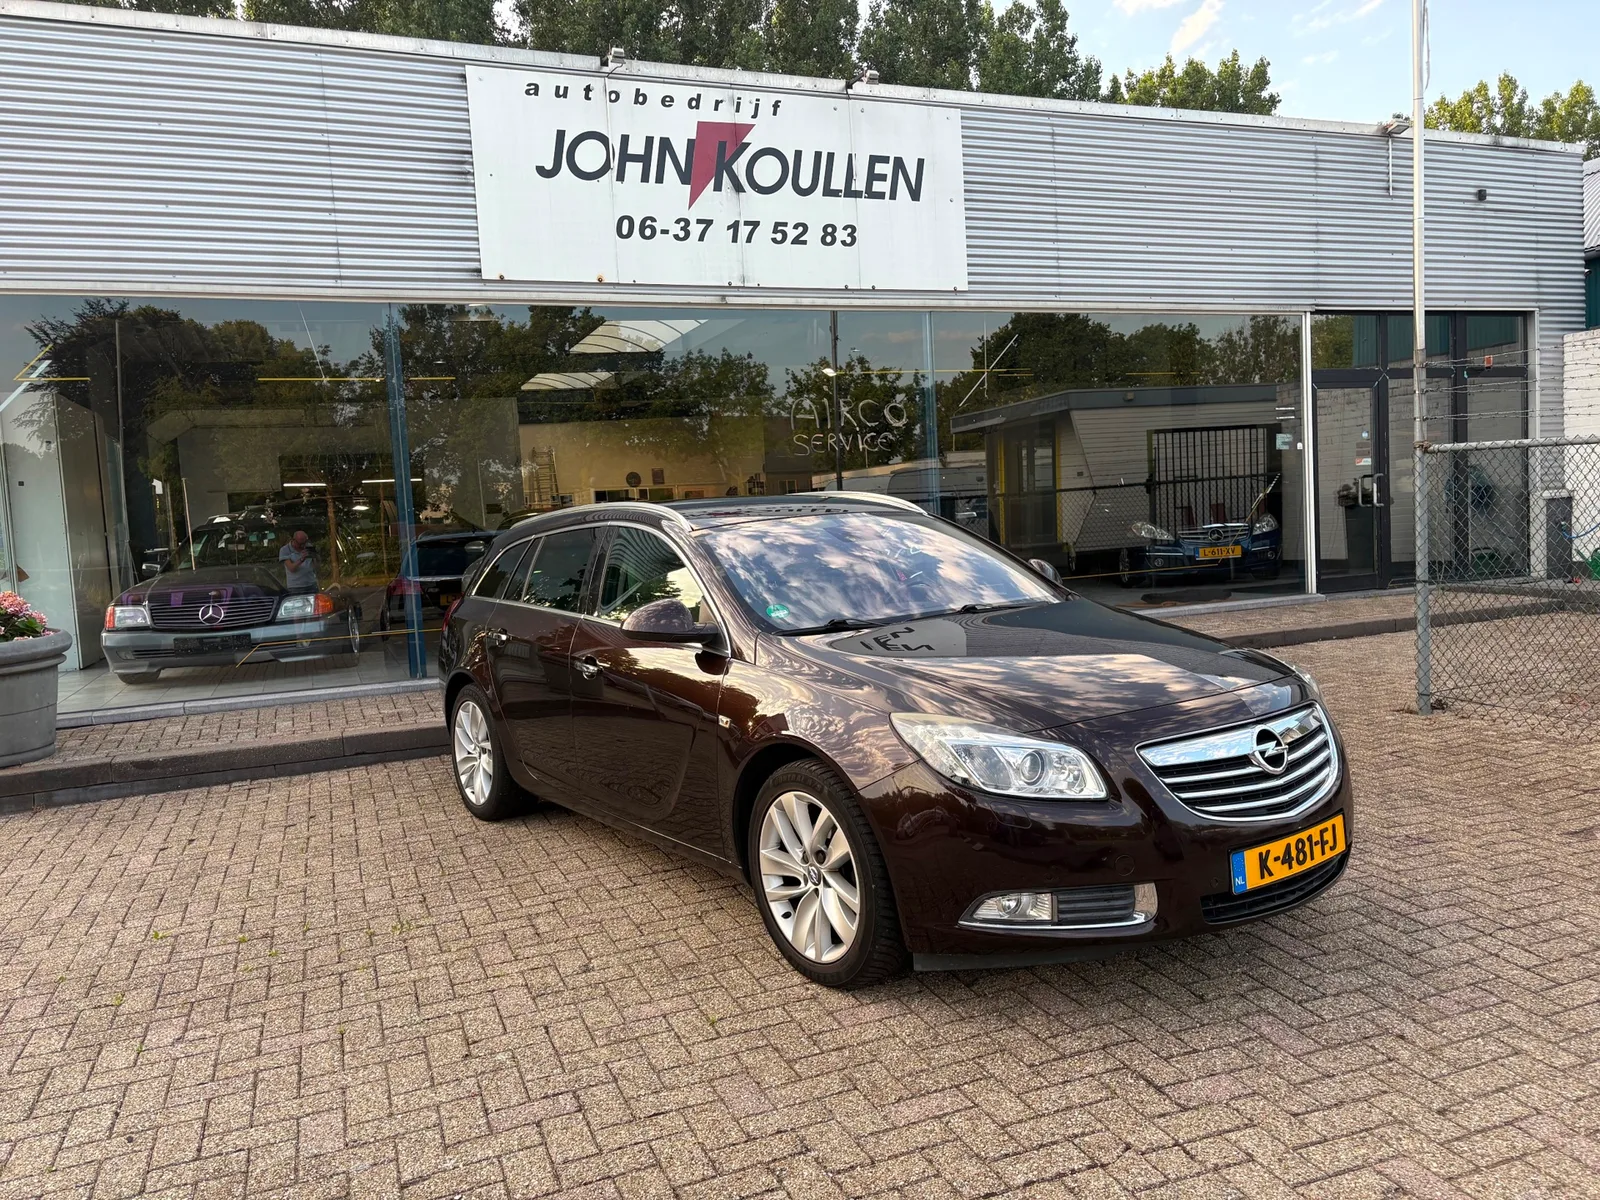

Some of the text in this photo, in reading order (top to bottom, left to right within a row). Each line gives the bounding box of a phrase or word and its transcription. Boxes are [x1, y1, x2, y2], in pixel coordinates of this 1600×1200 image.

[524, 82, 782, 119] autobedrijf
[535, 129, 925, 202] JOHN KOULLEN
[615, 214, 858, 247] 06-37 17 52 83
[1258, 823, 1338, 880] K-481-FJ
[1235, 876, 1245, 886] NL
